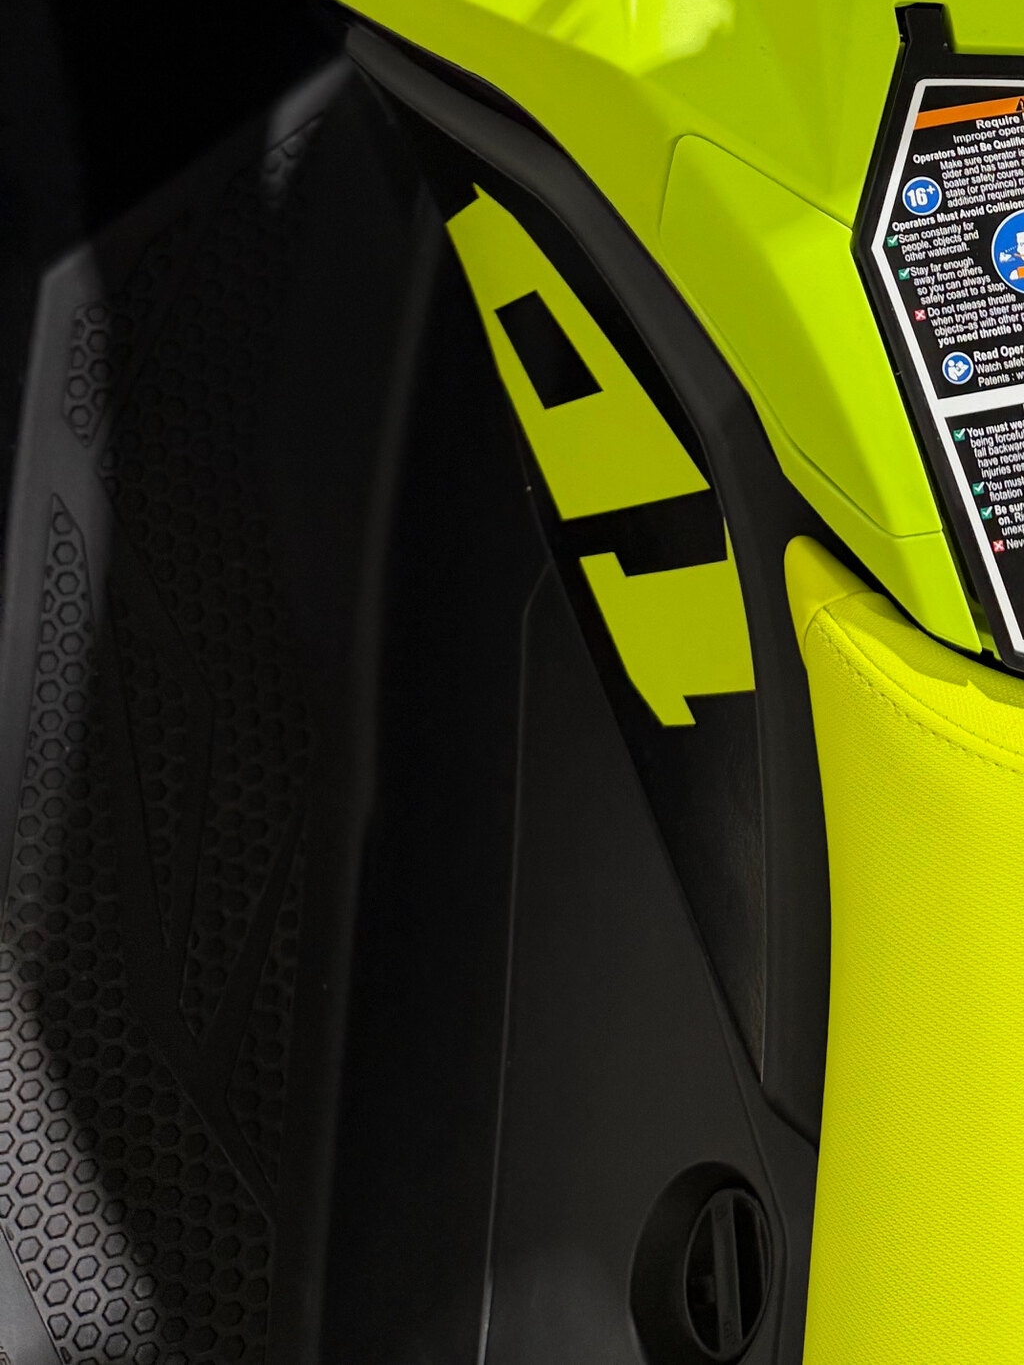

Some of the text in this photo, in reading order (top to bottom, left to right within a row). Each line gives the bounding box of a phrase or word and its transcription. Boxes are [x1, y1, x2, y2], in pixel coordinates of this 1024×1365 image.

[976, 116, 1020, 129] Require
[953, 131, 996, 144] Improper
[912, 150, 956, 164] Operators
[956, 144, 979, 155] Must
[979, 142, 992, 151] Be
[939, 159, 963, 169] Make
[963, 157, 982, 165] sure
[983, 150, 1016, 164] operator
[1017, 148, 1024, 156] is
[941, 169, 962, 179] older
[963, 165, 979, 175] and
[980, 164, 996, 173] has
[997, 160, 1020, 170] taken
[943, 178, 969, 188] boater
[971, 173, 995, 184] safety
[945, 188, 965, 198] state
[966, 186, 978, 196] (or
[979, 178, 1018, 194] province)
[907, 185, 936, 207] 16+
[947, 193, 986, 207] additional
[891, 217, 935, 232] Operators
[936, 211, 958, 222] Must
[959, 206, 985, 218] Avoid
[897, 222, 974, 243] Scan constantly for
[901, 230, 979, 255] people, objects and
[904, 242, 970, 262] other watercraft.
[910, 257, 974, 276] Stay far enough
[913, 267, 983, 286] away from others
[927, 293, 1016, 316] Do not release throttle
[931, 316, 953, 326] when
[954, 312, 978, 323] trying
[978, 309, 988, 317] to
[988, 306, 1009, 316] steer
[938, 337, 955, 348] you
[956, 331, 978, 342] need
[979, 325, 1012, 338] throttle
[1012, 323, 1022, 332] to
[973, 348, 999, 361] Read
[975, 361, 1002, 374] Watch
[977, 374, 1010, 386] Patents
[994, 505, 1007, 515] Be
